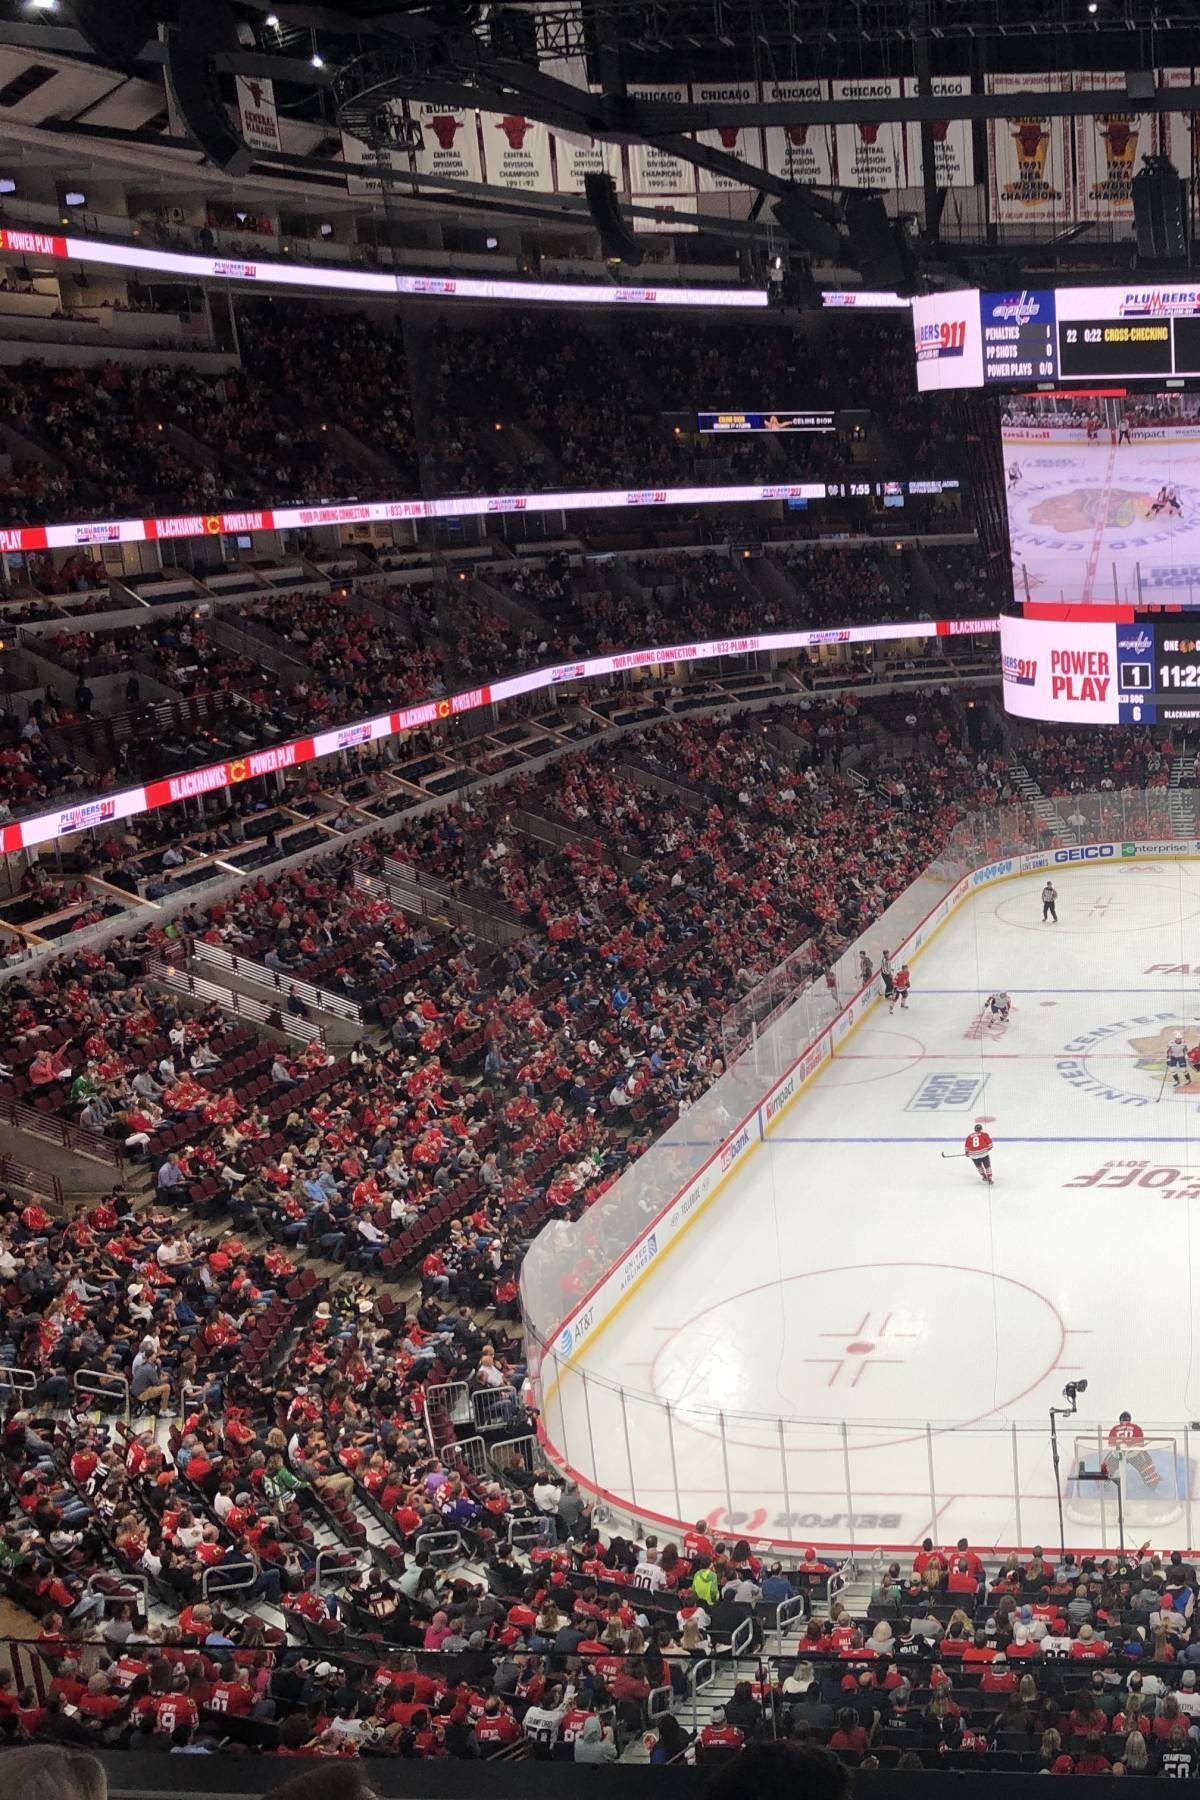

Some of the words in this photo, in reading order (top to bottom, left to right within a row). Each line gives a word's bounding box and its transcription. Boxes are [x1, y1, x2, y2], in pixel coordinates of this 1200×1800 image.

[700, 89, 750, 101] CHICAGO
[771, 88, 821, 99] CHICAGO
[842, 86, 892, 97] CHICAGO
[503, 161, 534, 169] DIVISION
[850, 166, 892, 175] CHAMPIONS
[499, 169, 540, 178] CHAMPIONS
[642, 169, 683, 178] CHAMPIONS
[1001, 192, 1062, 201] CHAMPIONS
[8, 233, 34, 253] POWER
[35, 236, 53, 254] PLAY
[940, 321, 965, 347] 911
[985, 327, 1020, 341] PENALTIES
[1066, 329, 1077, 343] 22
[1084, 328, 1102, 342] 0:22
[1104, 326, 1168, 342] CROSS-CHECKING
[986, 346, 997, 358] PP
[996, 345, 1018, 358] SHOTS
[987, 364, 1010, 377] POWER
[1010, 363, 1032, 376] PLAYS
[1039, 362, 1053, 375] 0/0
[793, 417, 814, 425] CELINE
[816, 417, 832, 425] DION
[1131, 429, 1166, 440] impact
[850, 484, 870, 496] 7:55
[108, 525, 120, 539] 911
[156, 516, 203, 537] BLACKHAWKS
[224, 513, 246, 532] POWER
[246, 513, 263, 530] PLAY
[0, 530, 21, 550] PLAY
[950, 618, 1000, 634] BLACKHAWKS
[1164, 640, 1179, 651] ONE
[612, 656, 625, 669] YOUR
[626, 651, 656, 667] PLUMBING
[656, 646, 697, 663] CONNECTION
[1051, 650, 1109, 675] POWER
[1018, 660, 1037, 677] 911
[1132, 666, 1140, 685] 1
[1051, 675, 1110, 701] PLAY
[1130, 694, 1144, 704] SOG
[400, 703, 437, 729] BLACKHAWKS
[1133, 706, 1141, 721] 6
[169, 767, 227, 796] BLACKHAWKS
[250, 751, 277, 775] POWER
[277, 746, 296, 769] PLAY
[100, 800, 115, 816] 911
[1054, 845, 1114, 863] GEICO
[1064, 1012, 1176, 1053] CENTER
[944, 1078, 979, 1105] BUD
[1056, 1060, 1149, 1107] UNITED
[770, 1076, 796, 1119] impact
[914, 1074, 958, 1110] LIGHT
[730, 1128, 750, 1160] bank
[972, 1136, 980, 1148] 8
[1104, 1160, 1150, 1168] 2019
[624, 1245, 648, 1275] UNITED
[620, 1256, 649, 1291] AIRLINES
[573, 1306, 595, 1340] AT&T
[772, 1512, 903, 1529] BELFOR
[1163, 1753, 1191, 1763] CRAWFORD
